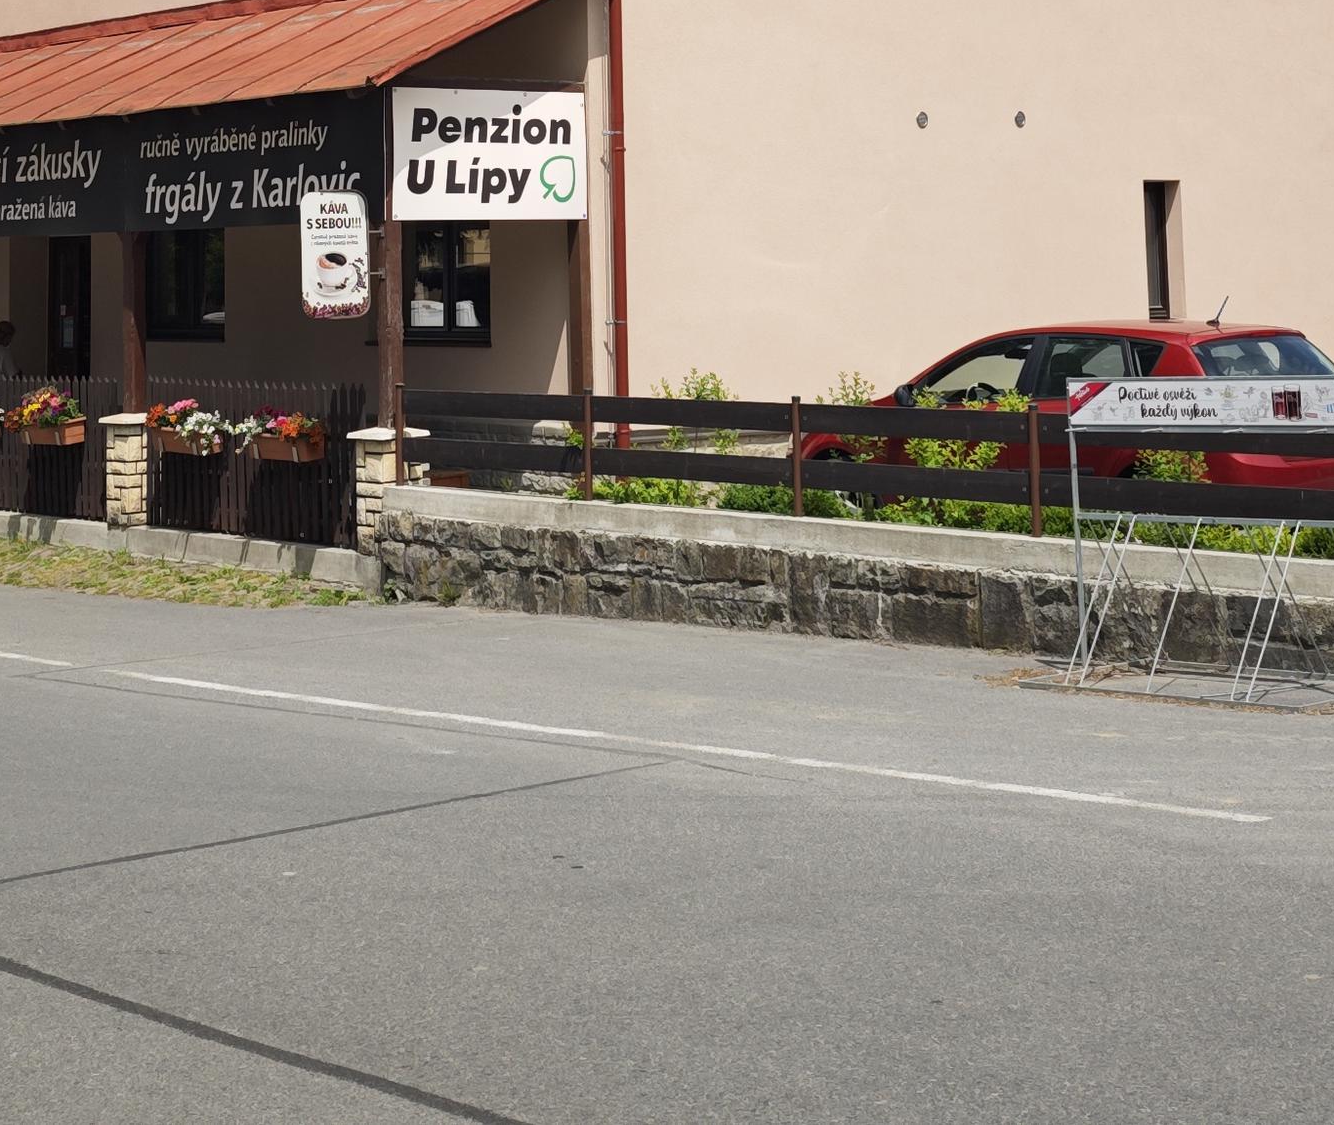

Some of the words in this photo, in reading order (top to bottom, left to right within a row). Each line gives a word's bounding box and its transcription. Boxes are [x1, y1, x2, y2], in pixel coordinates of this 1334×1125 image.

[139, 133, 181, 159] ručně
[184, 125, 257, 161] vyráběné
[261, 120, 328, 155] pralinky
[411, 104, 571, 145] Penzion
[15, 139, 102, 188] zákusky
[406, 159, 435, 195] U
[445, 157, 531, 204] Lípy
[48, 198, 77, 220] káva
[145, 170, 222, 224] frgály
[230, 180, 244, 210] z
[320, 200, 348, 214] KÁVA
[307, 218, 313, 229] S
[316, 217, 362, 229] SEBOU!!!
[1140, 403, 1178, 421] každý
[1181, 405, 1219, 420] výkon
